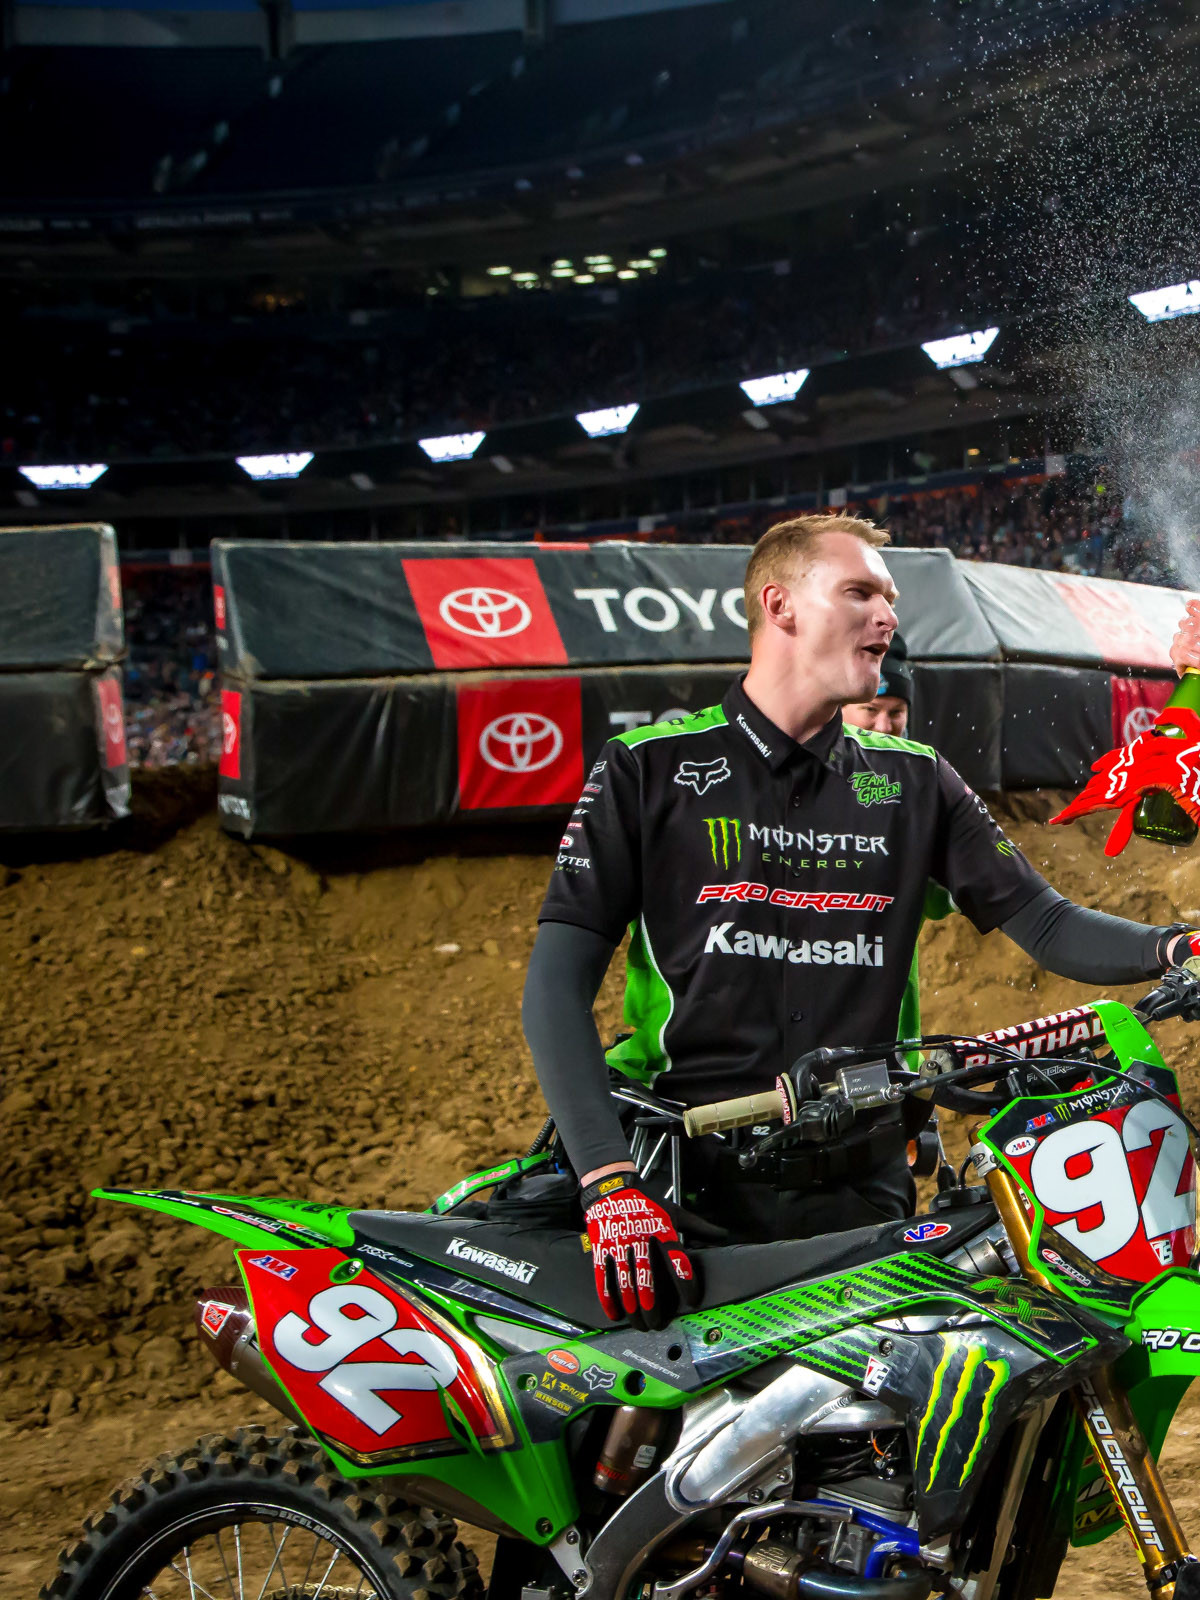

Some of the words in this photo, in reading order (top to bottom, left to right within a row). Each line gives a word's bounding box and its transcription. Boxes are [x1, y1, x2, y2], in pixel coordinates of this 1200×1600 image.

[737, 713, 772, 758] Kawasaki
[852, 772, 888, 791] TEAM
[857, 782, 901, 804] GREEN
[748, 822, 889, 856] MONSTER
[762, 853, 864, 869] ENERGY
[696, 881, 768, 905] PRO
[769, 888, 895, 913] CIRCUIT
[703, 921, 884, 968] Kawasaki
[1068, 1082, 1134, 1111] MONSTER
[1025, 1112, 1057, 1133] AMA
[1011, 1139, 1031, 1153] AMA
[1030, 1098, 1196, 1262] 92
[585, 1194, 650, 1222] Mechanix
[598, 1212, 666, 1240] Mechanix
[905, 1223, 936, 1240] VP
[249, 1255, 298, 1280] AMA
[444, 1238, 540, 1285] Kawasaki
[272, 1284, 459, 1437] 92
[1101, 1438, 1166, 1553] CIRCUIT
